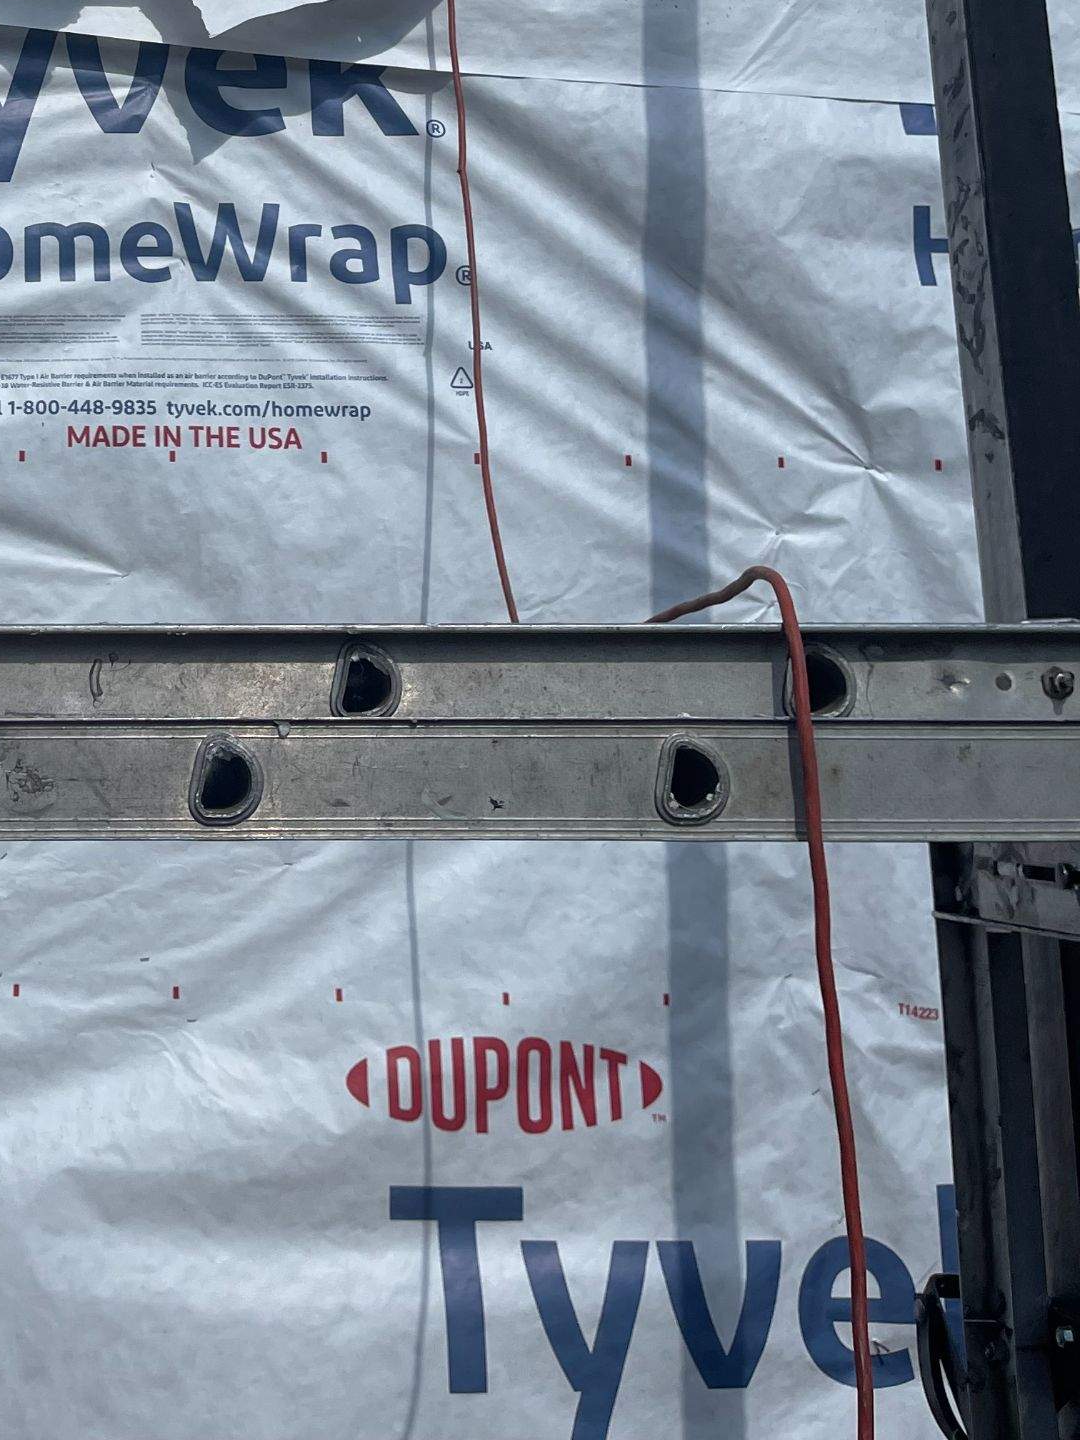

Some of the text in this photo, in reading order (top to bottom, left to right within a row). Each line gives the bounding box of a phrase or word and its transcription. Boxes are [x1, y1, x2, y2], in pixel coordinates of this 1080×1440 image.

[8, 400, 157, 415] 1-800-448-9835
[167, 400, 371, 421] tyvek.com/homewrap
[67, 425, 302, 449] MADE IN THE USA
[386, 1036, 628, 1134] DUPONT
